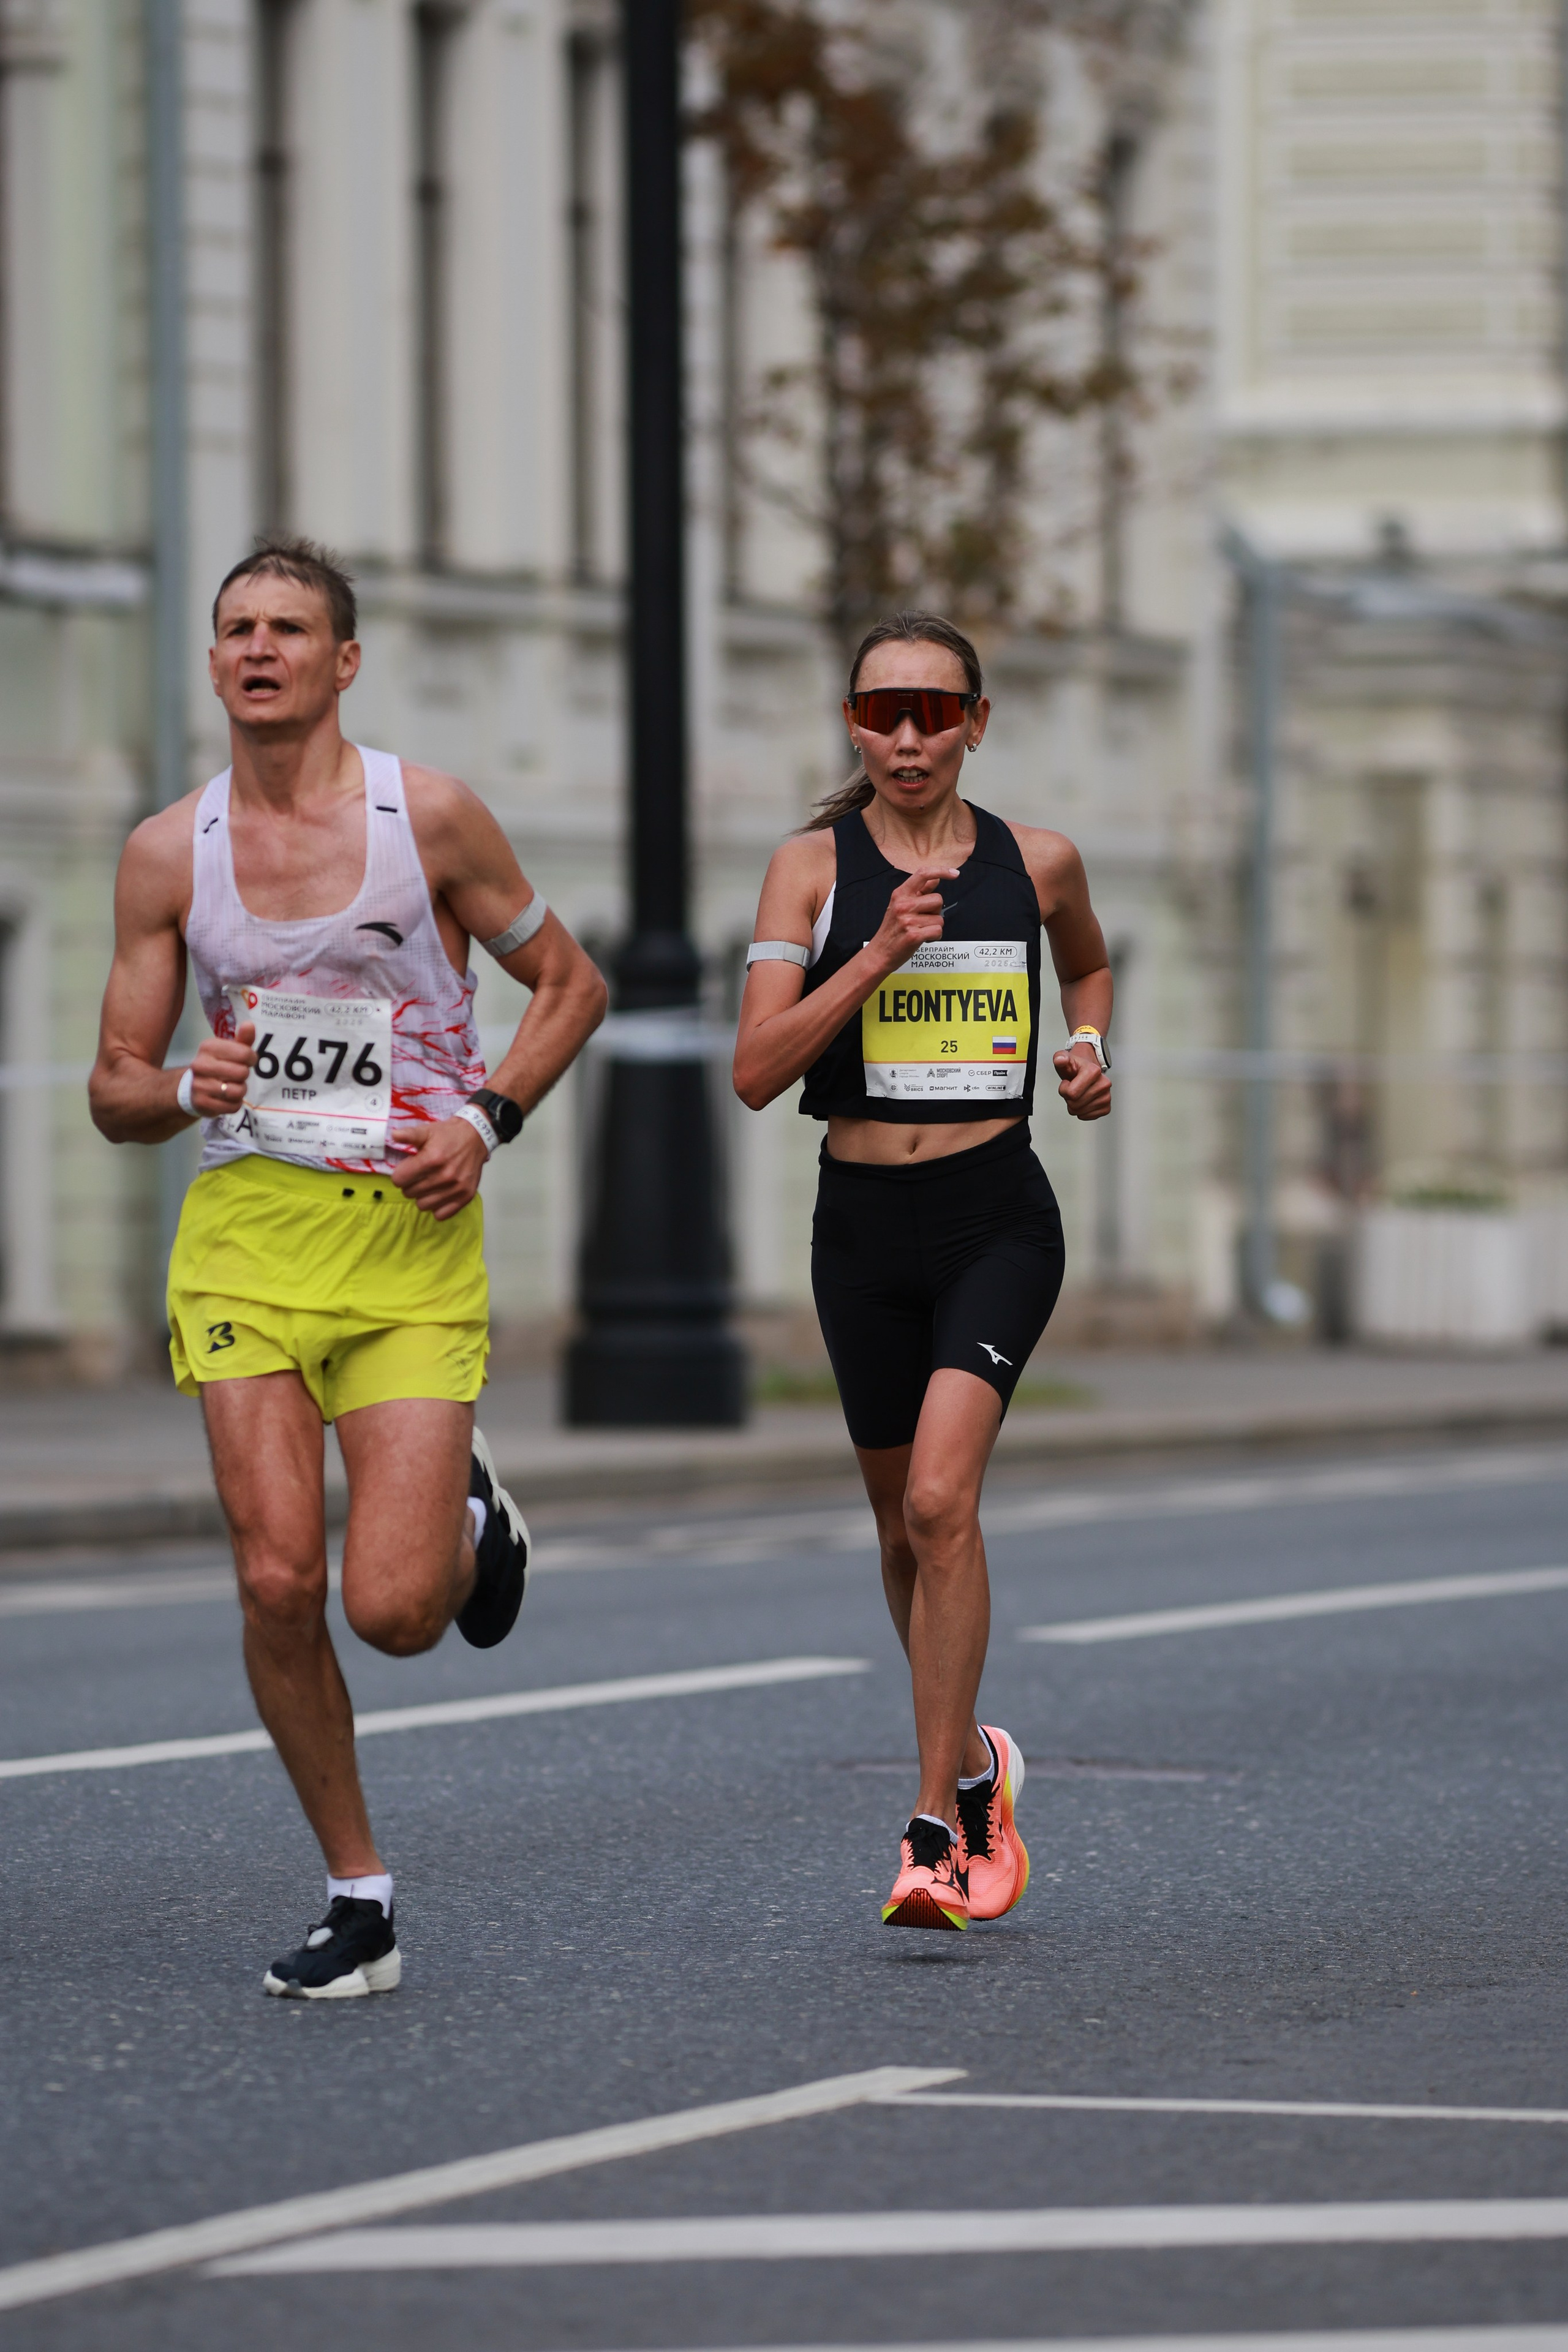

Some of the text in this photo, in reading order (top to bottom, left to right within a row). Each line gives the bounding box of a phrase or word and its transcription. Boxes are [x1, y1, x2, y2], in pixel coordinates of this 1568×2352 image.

[911, 952, 970, 960] МОСКОВСКИЙ
[879, 989, 1018, 1023] LEONTYEVA
[940, 1039, 958, 1054] 25
[282, 1087, 317, 1101] ПЕТР
